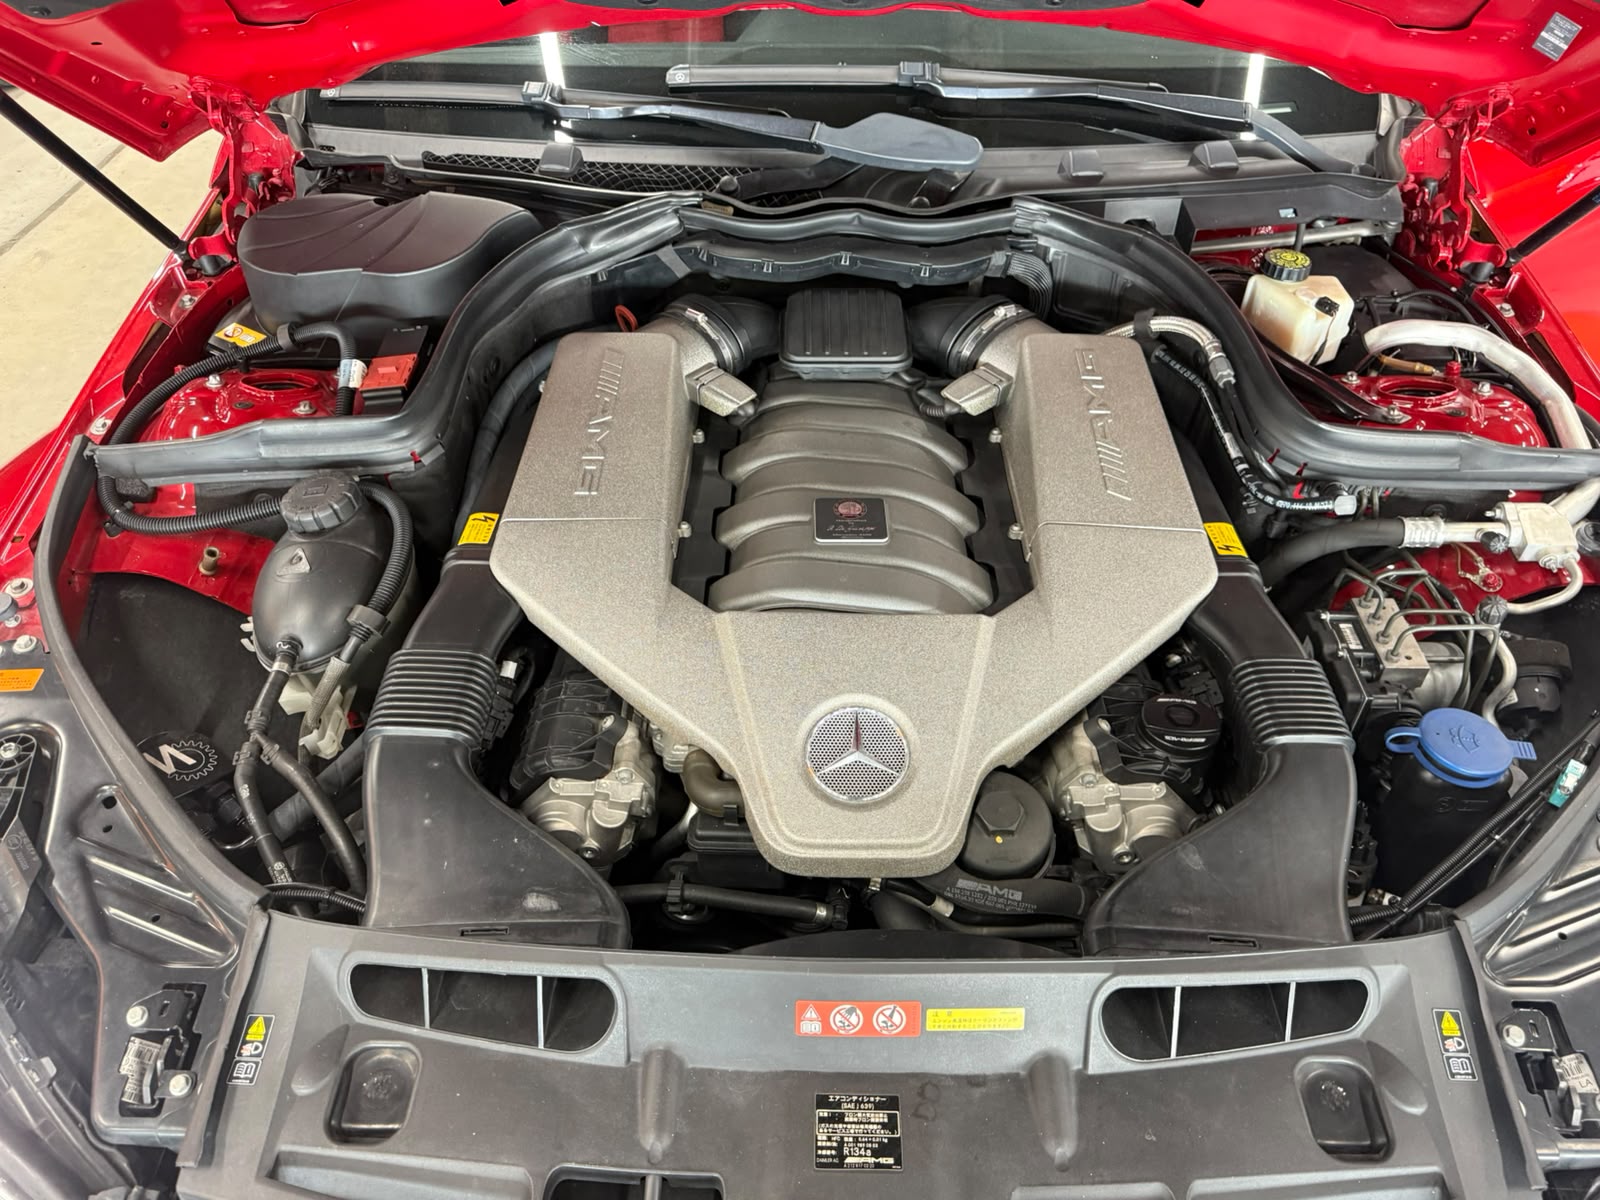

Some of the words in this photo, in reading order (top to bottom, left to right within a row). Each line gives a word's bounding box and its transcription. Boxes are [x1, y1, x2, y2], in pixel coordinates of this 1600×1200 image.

[1075, 349, 1112, 441] AMG
[574, 394, 615, 495] AMG
[976, 882, 1023, 901] AMG
[828, 1095, 887, 1103] エアコンディショナー
[843, 1147, 872, 1157] R134a
